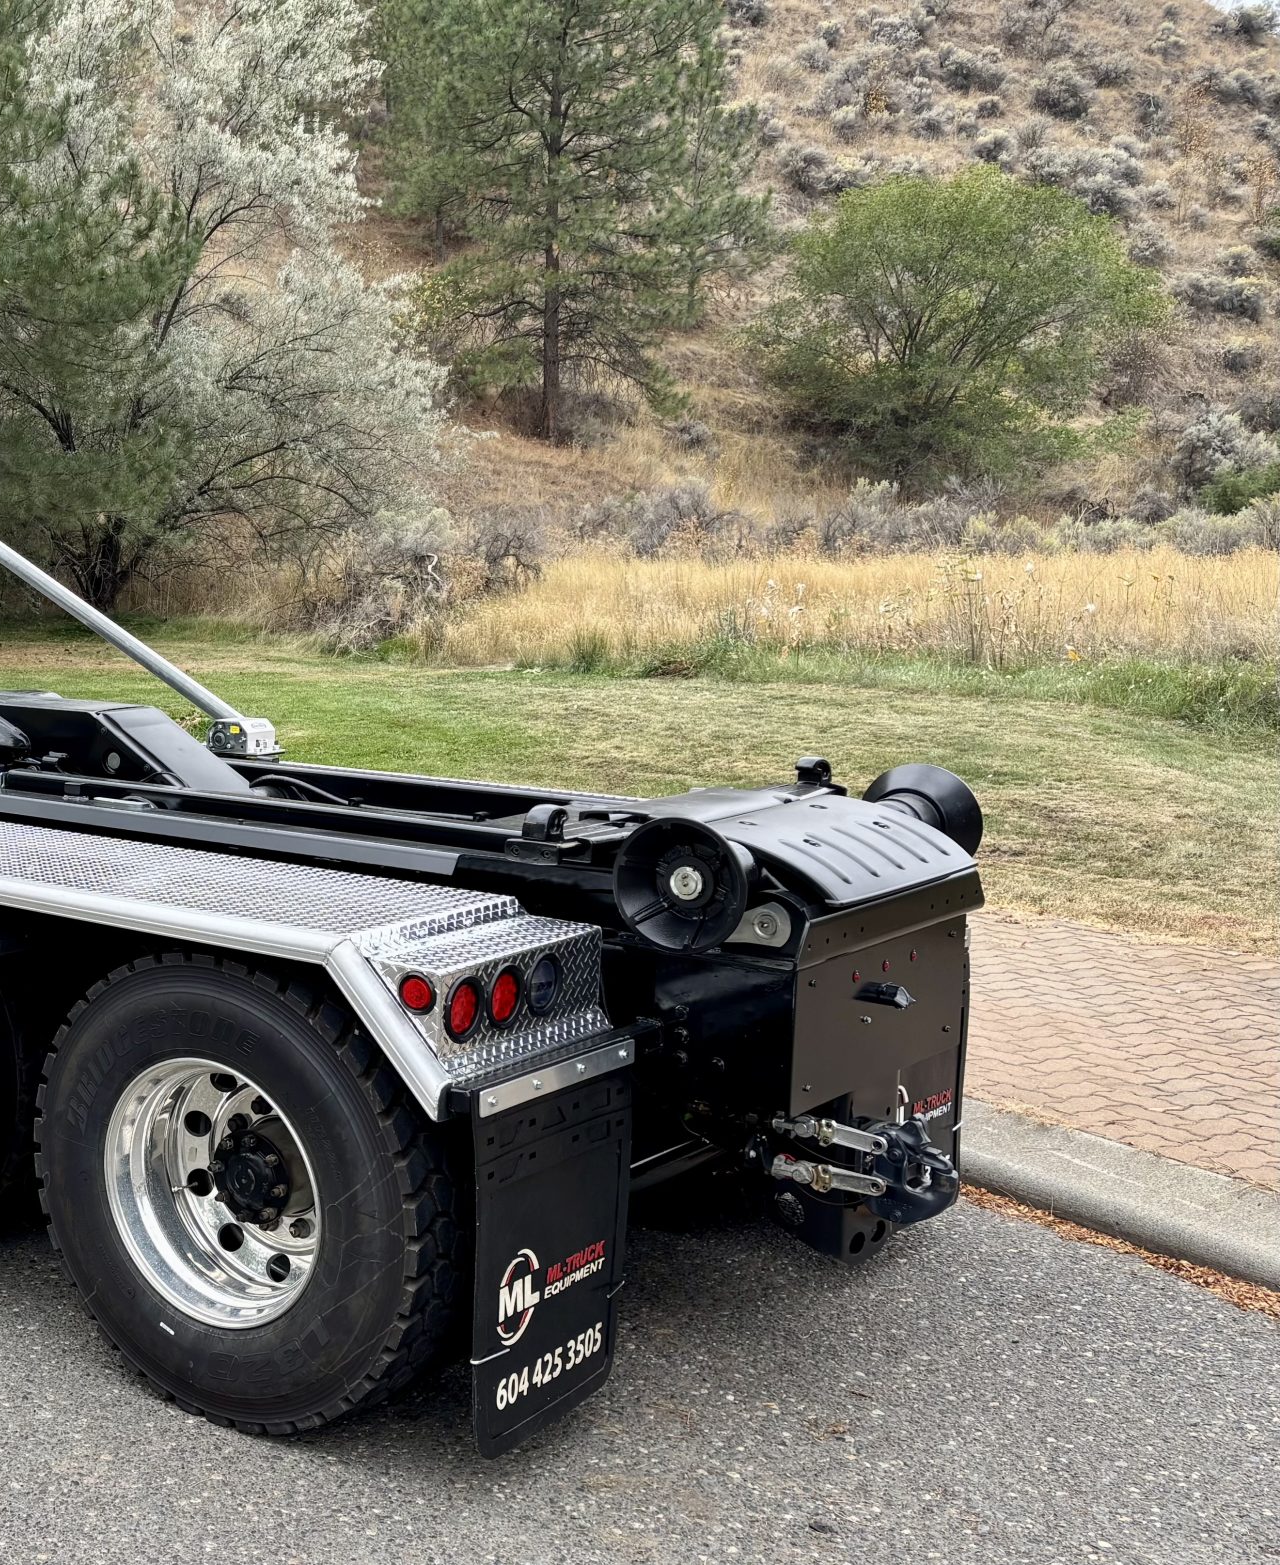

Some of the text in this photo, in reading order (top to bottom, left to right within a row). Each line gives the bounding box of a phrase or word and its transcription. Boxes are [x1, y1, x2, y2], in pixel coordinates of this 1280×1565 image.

[66, 1008, 261, 1136] BRIDGESTONE
[544, 1257, 606, 1300] EQUIPMENT
[546, 1240, 606, 1285] ML-TRUCK
[498, 1274, 541, 1323] ML
[496, 1321, 604, 1411] 604 425 3505
